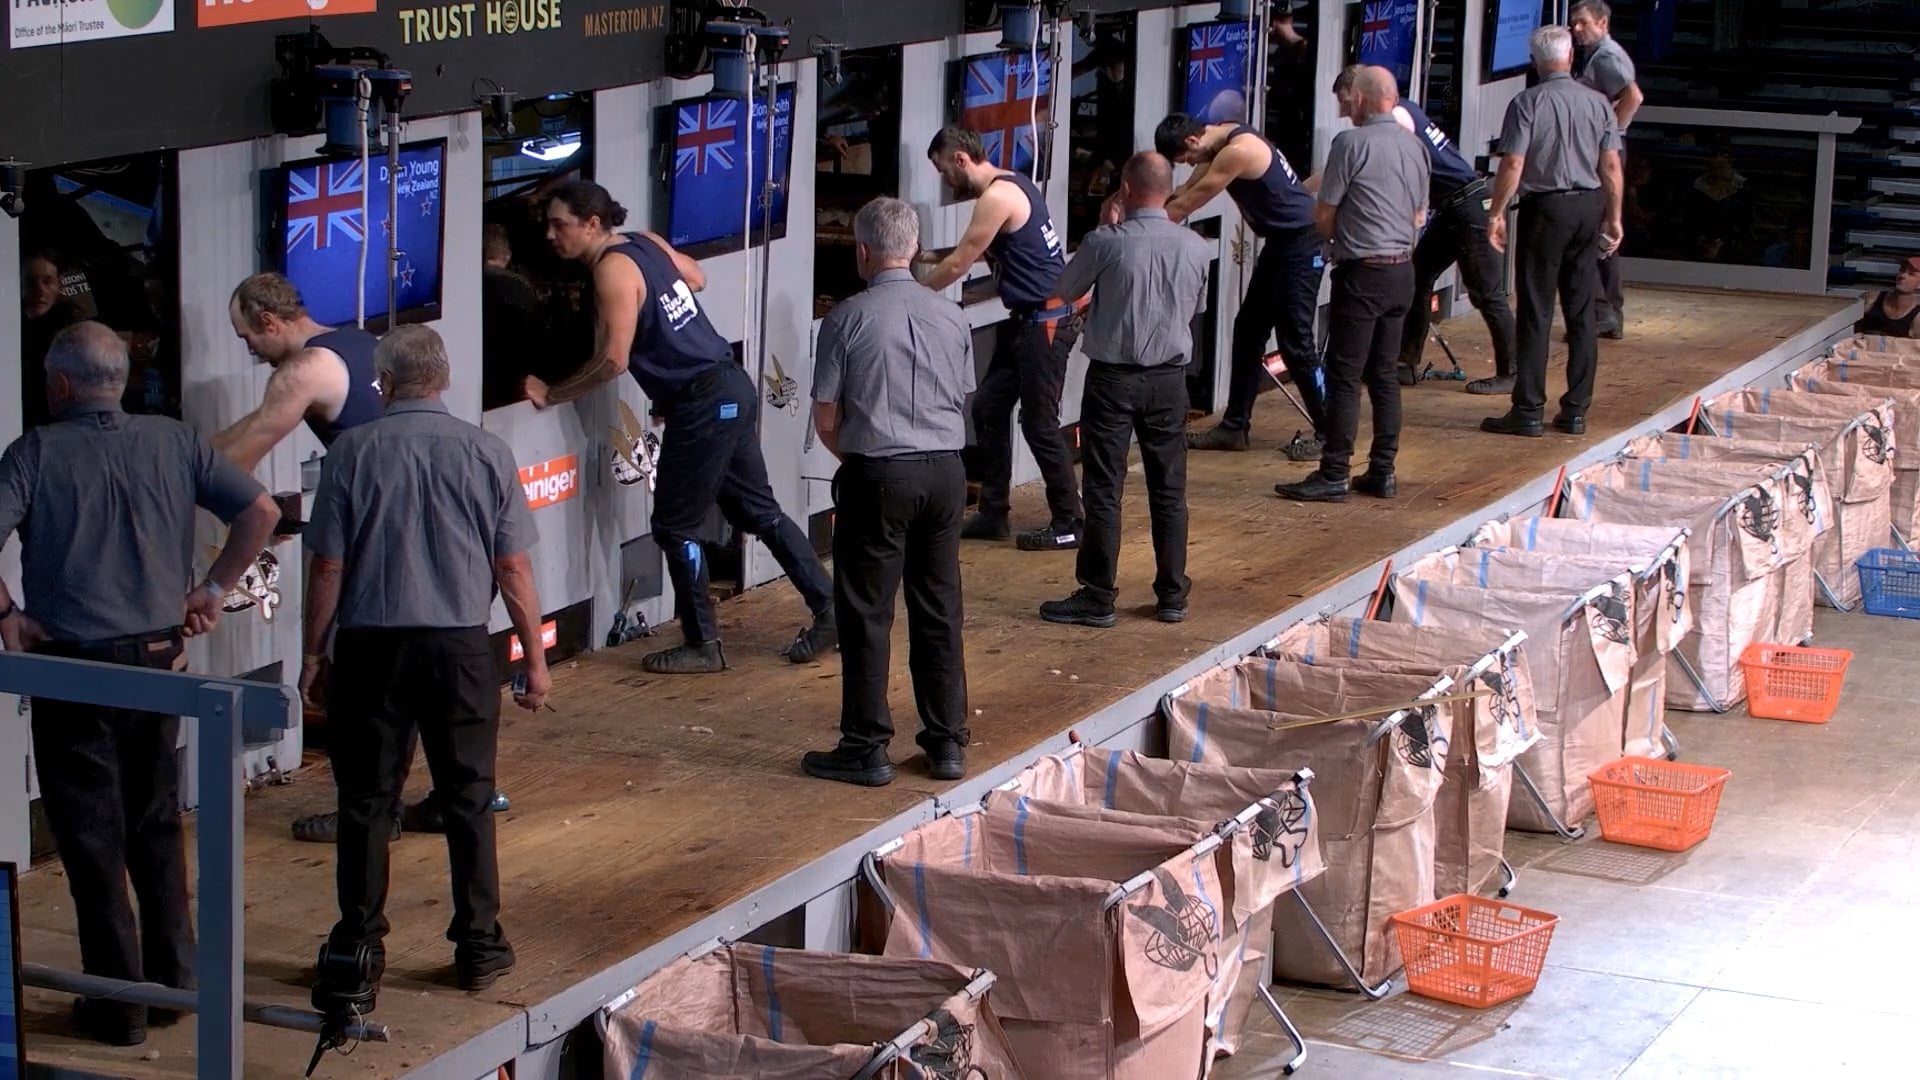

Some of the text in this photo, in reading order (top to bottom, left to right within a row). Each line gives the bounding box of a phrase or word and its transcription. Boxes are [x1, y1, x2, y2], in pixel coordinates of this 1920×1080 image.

[15, 26, 35, 38] Office
[36, 24, 44, 36] of
[45, 23, 57, 34] the
[79, 20, 105, 31] Trustee
[398, 0, 562, 44] TRUST HOUSE
[584, 6, 665, 37] MASTERTON.NZ
[410, 160, 439, 177] Young
[411, 177, 439, 192] Zealand
